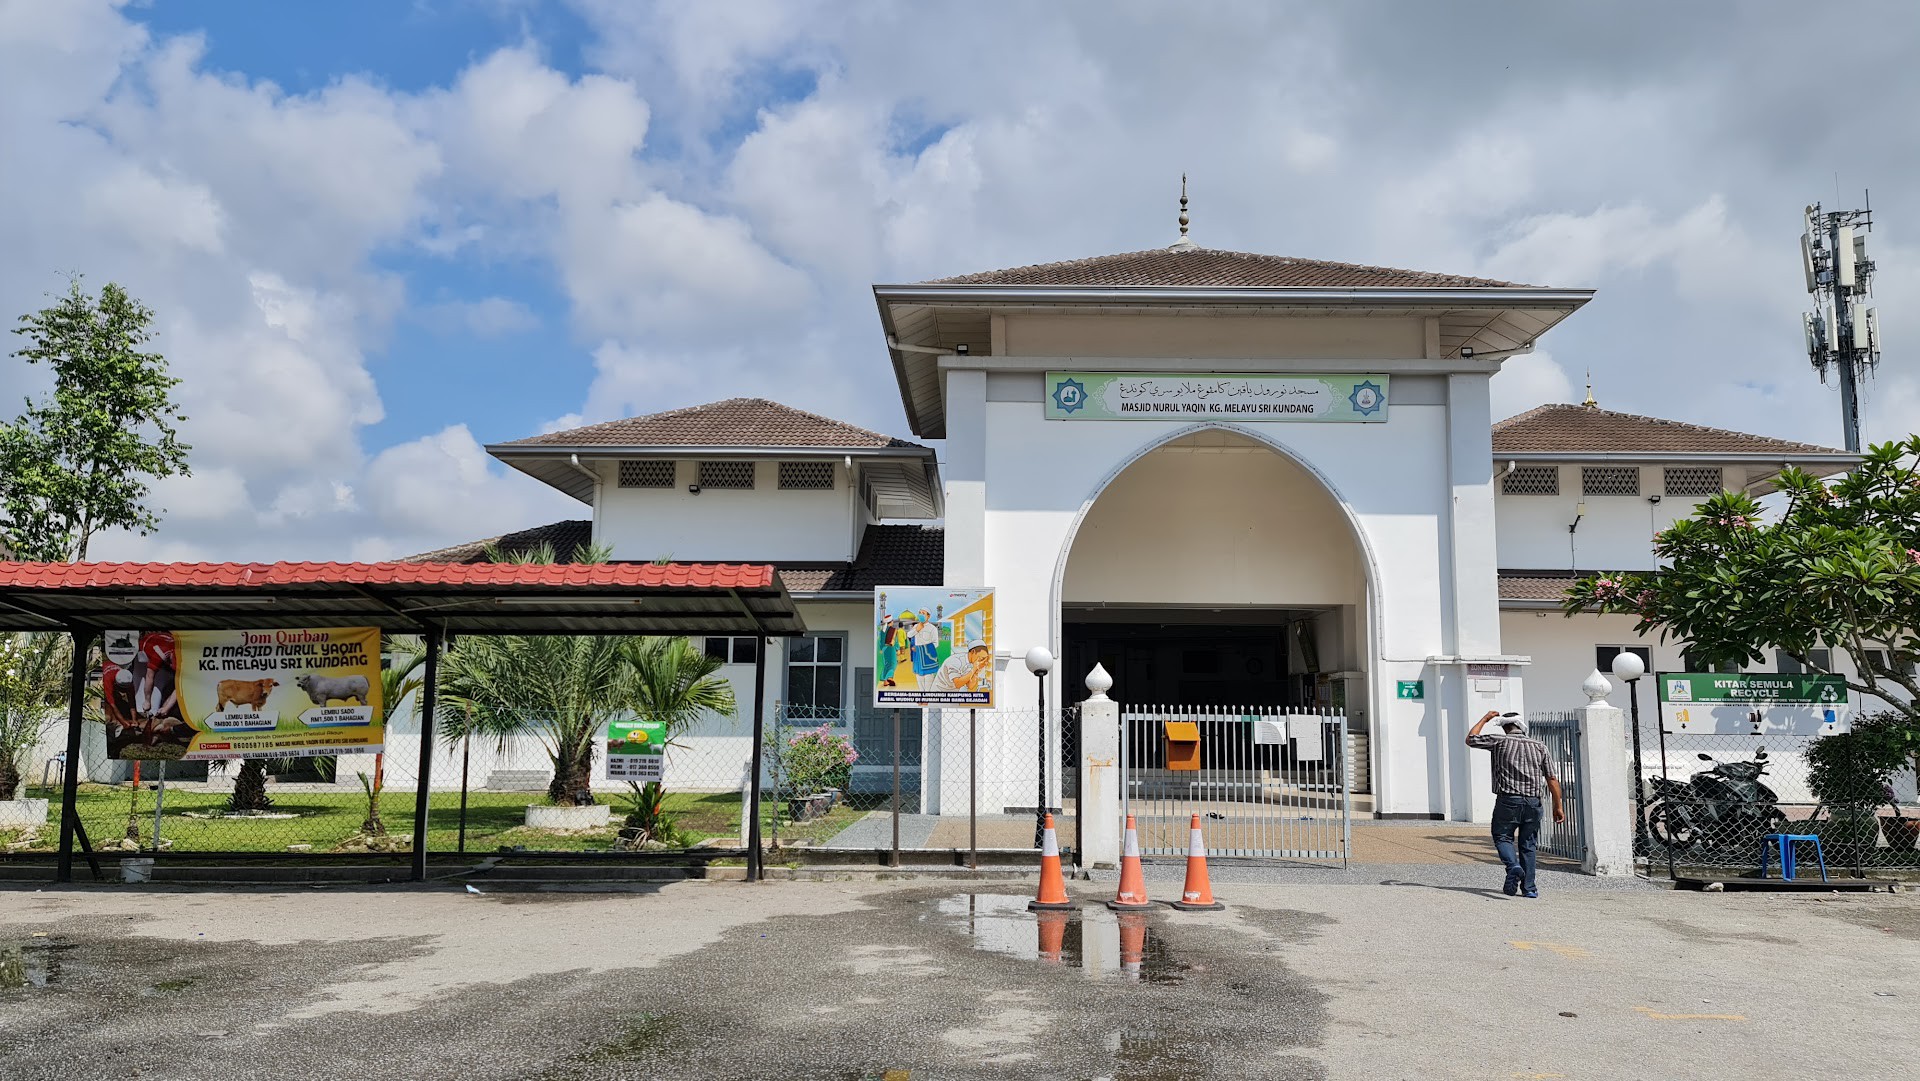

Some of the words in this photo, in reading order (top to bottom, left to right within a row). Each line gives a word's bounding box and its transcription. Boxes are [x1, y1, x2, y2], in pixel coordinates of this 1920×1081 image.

[1149, 386, 1173, 397] سري
[1173, 381, 1196, 397] ملايو
[1253, 384, 1287, 398] نورول
[1288, 384, 1319, 397] مسجد
[1121, 403, 1151, 412] MASJID
[1152, 403, 1180, 412] NURUL
[1182, 403, 1206, 413] YAQIN
[1209, 403, 1223, 413] KG.
[1224, 404, 1257, 413] MELAYU
[1258, 404, 1271, 413] SRI
[1272, 404, 1314, 414] KUNDANG
[241, 631, 272, 647] Jom
[276, 630, 329, 647] Qurban
[202, 646, 218, 658] DI
[221, 645, 273, 658] MASJID
[276, 644, 318, 656] NURUL
[321, 642, 363, 655] YAQIN
[199, 659, 219, 671] KG.
[222, 658, 277, 671] MELAYU
[280, 657, 302, 669] SRI
[305, 654, 368, 669] KUNDANG
[1714, 680, 1747, 689] KITAR
[1749, 680, 1794, 689] SEMULA
[1730, 689, 1780, 698] RECYCLE
